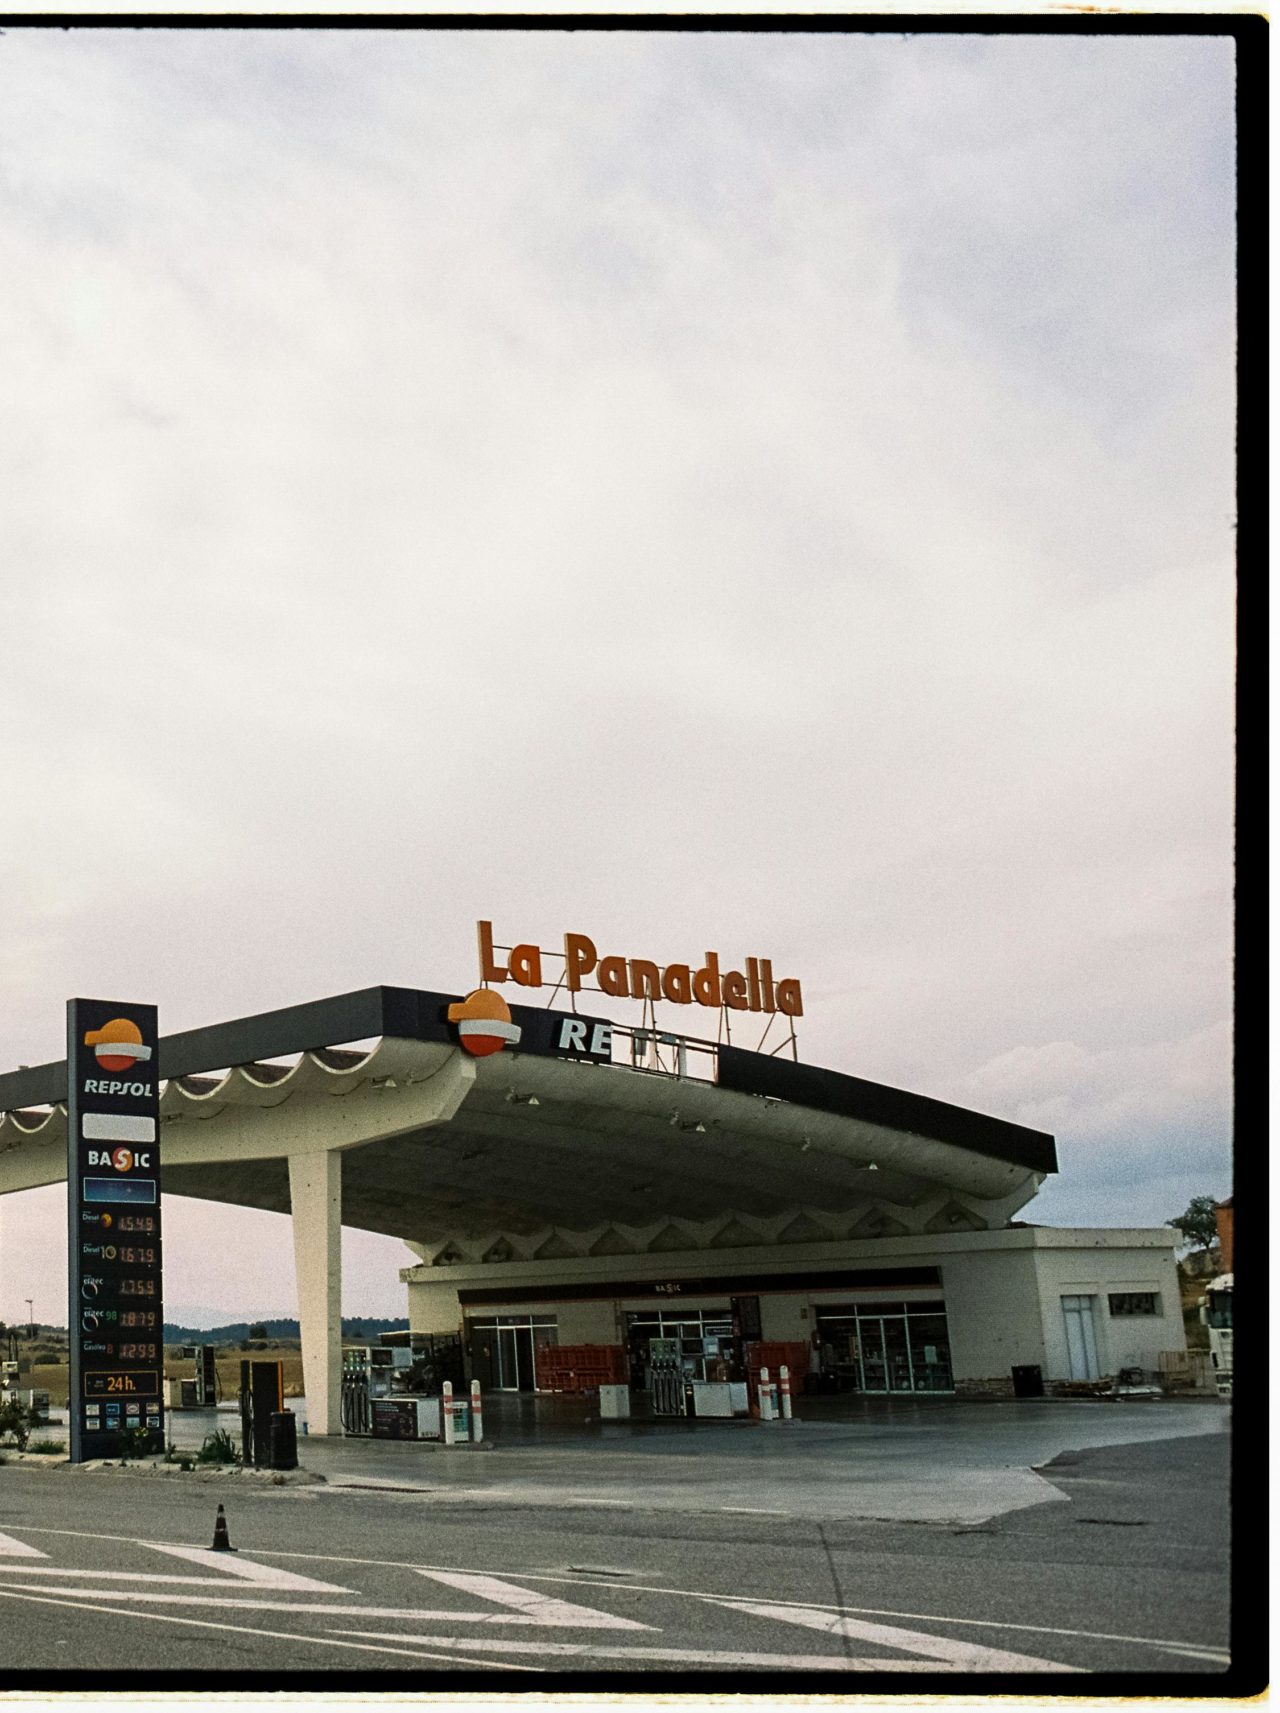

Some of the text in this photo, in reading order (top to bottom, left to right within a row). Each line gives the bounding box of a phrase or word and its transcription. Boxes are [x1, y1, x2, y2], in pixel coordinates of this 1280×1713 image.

[477, 920, 804, 1016] La Panadella
[85, 1080, 152, 1096] REPSOL
[88, 1149, 150, 1169] BASIC
[100, 1245, 117, 1260] 10
[655, 1283, 681, 1293] BASIC
[105, 1310, 117, 1321] 98
